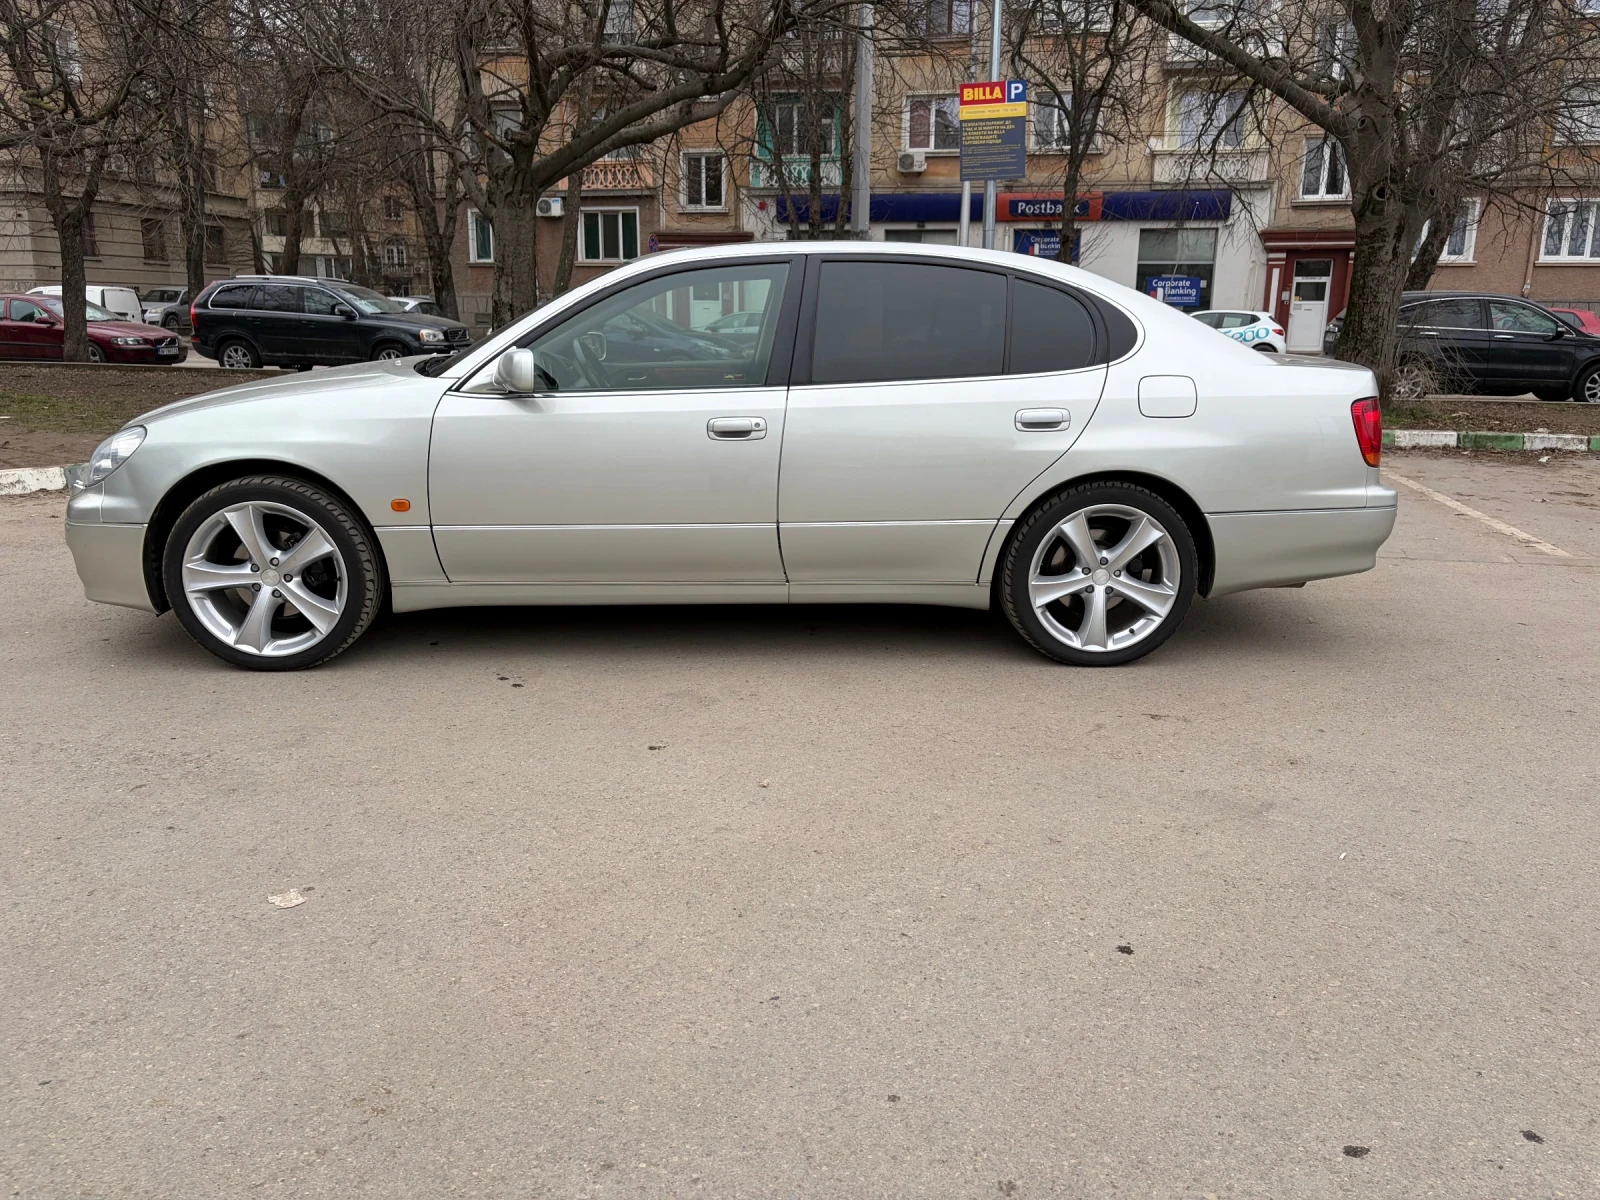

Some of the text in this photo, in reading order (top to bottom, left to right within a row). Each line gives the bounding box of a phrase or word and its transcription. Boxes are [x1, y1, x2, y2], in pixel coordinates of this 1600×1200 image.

[963, 83, 1024, 101] BILLA P
[1017, 201, 1080, 214] Postbak
[1152, 279, 1191, 287] Corporate
